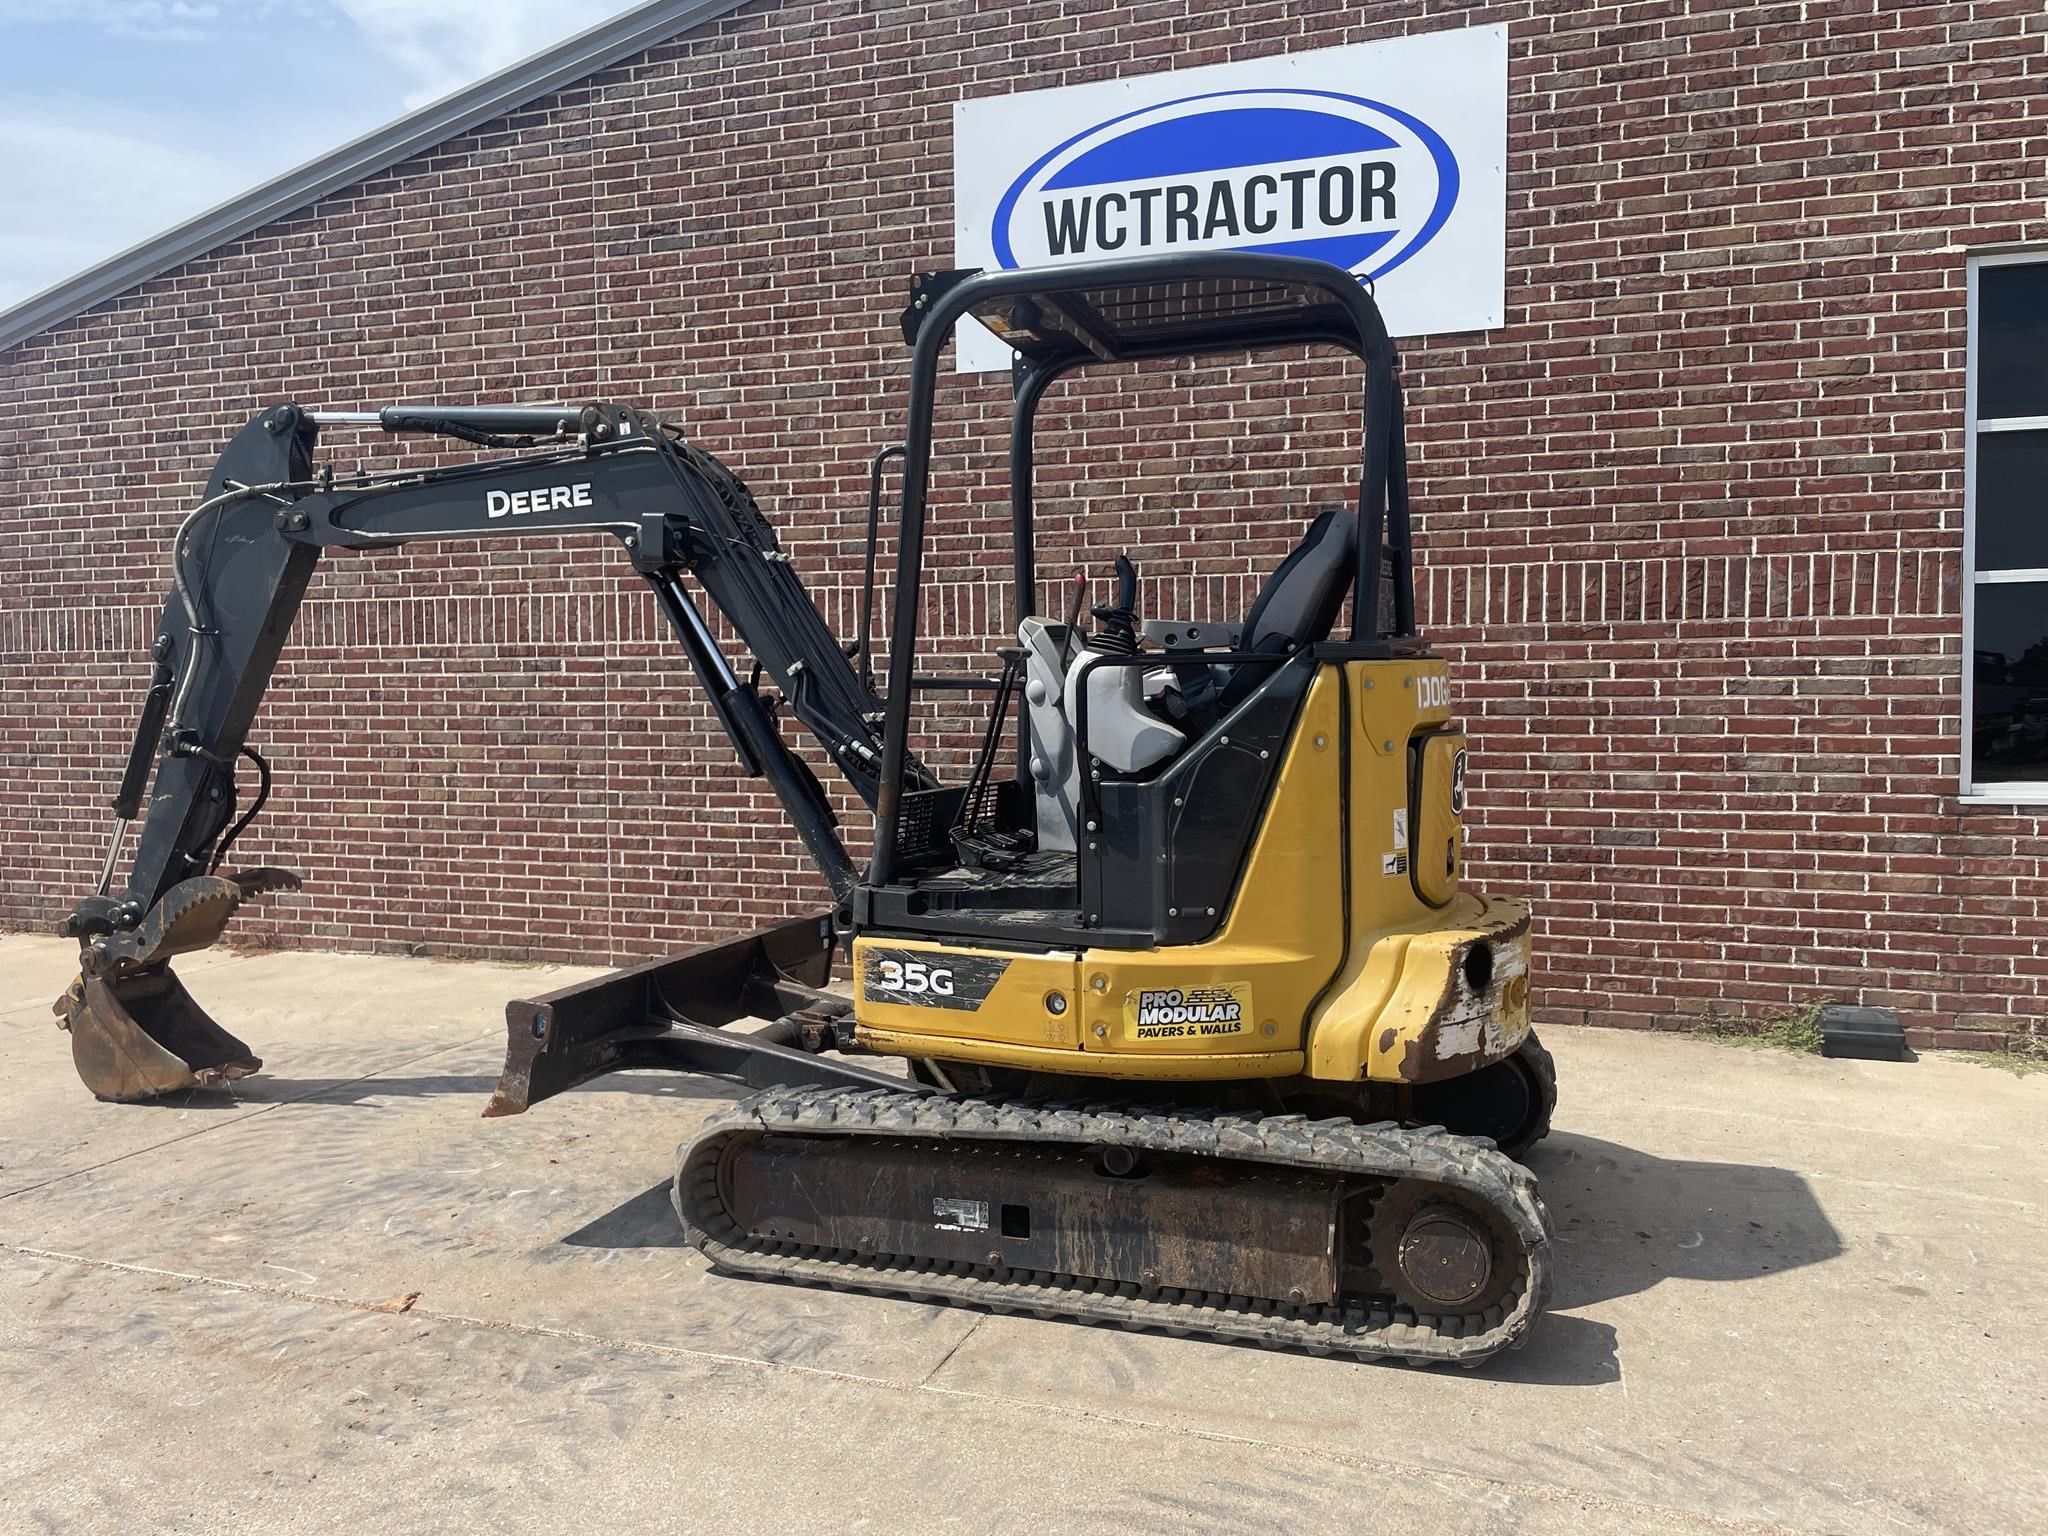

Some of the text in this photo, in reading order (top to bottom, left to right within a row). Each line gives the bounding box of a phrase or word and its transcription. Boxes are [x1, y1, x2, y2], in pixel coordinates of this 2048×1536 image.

[1043, 161, 1397, 256] WCTRACTOR
[486, 483, 593, 518] DEERE
[879, 960, 954, 995] 35G
[1140, 990, 1183, 1008] PRO
[1138, 1003, 1241, 1026] MODULAR
[1137, 1022, 1241, 1038] PAVERS & WALLS
